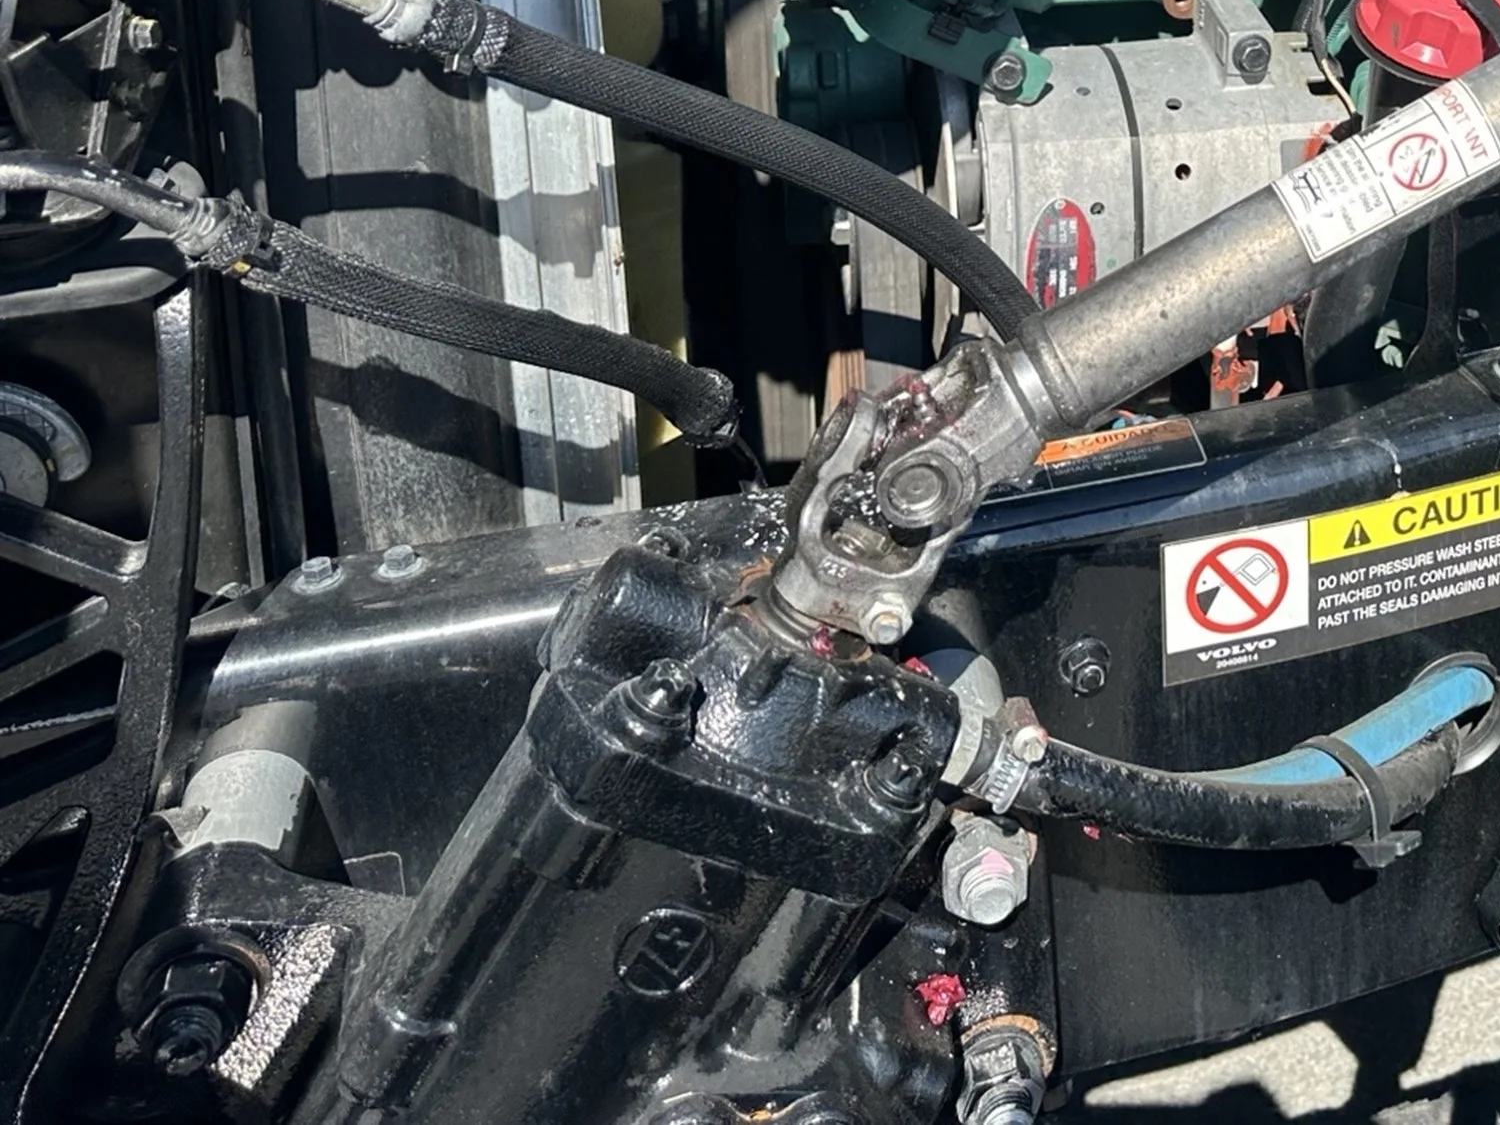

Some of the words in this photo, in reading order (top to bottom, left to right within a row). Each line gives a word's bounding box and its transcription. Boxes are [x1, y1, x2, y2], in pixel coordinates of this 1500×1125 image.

[1317, 575, 1337, 591] DO
[1340, 568, 1367, 586] NOT
[1369, 551, 1434, 580] PRESSURE
[1435, 541, 1472, 562] WASH
[1317, 584, 1382, 611] ATTACHED
[1384, 579, 1402, 594] TO
[1404, 575, 1418, 590] IT.
[1317, 610, 1350, 630] PAST
[1352, 604, 1377, 621] THE
[1379, 594, 1419, 614] SEALS
[1421, 577, 1486, 605] DAMAGING
[1196, 638, 1277, 662] VOLVO
